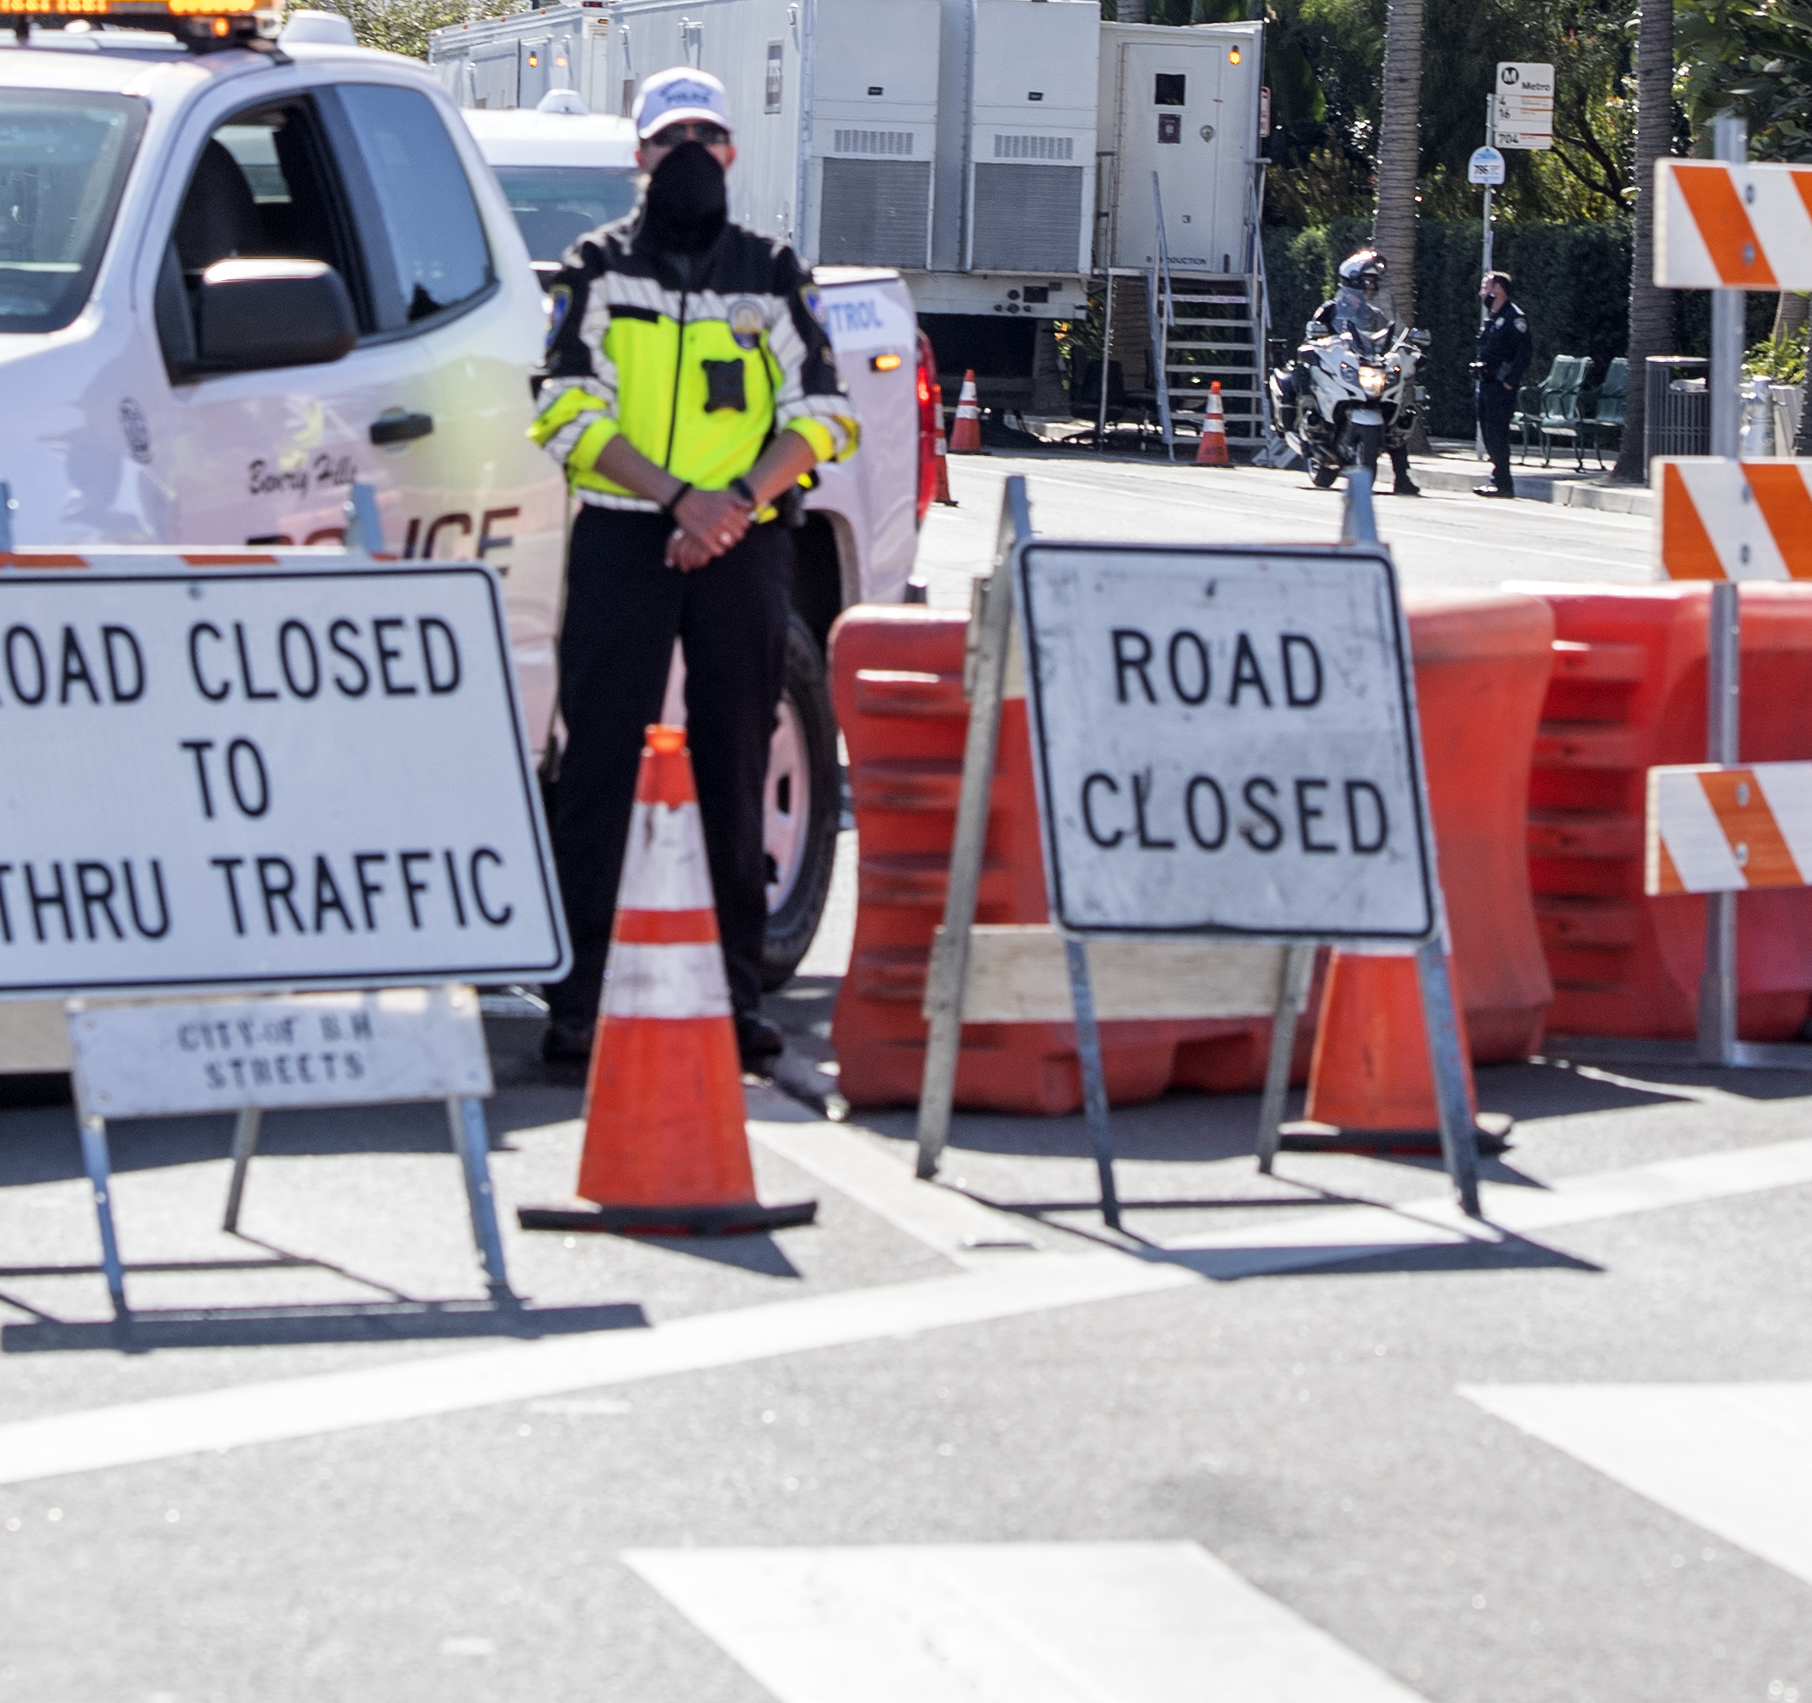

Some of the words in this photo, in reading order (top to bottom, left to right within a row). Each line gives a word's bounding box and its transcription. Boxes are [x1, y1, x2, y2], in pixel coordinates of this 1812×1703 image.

[1521, 82, 1551, 92] Metro
[1498, 133, 1519, 144] 704
[188, 616, 462, 702] CLOSED
[1111, 627, 1325, 709] ROAD
[181, 736, 270, 818] TO
[1081, 771, 1389, 855] CLOSED
[211, 847, 513, 935] TRAFFIC
[203, 1050, 366, 1090] STREETS
